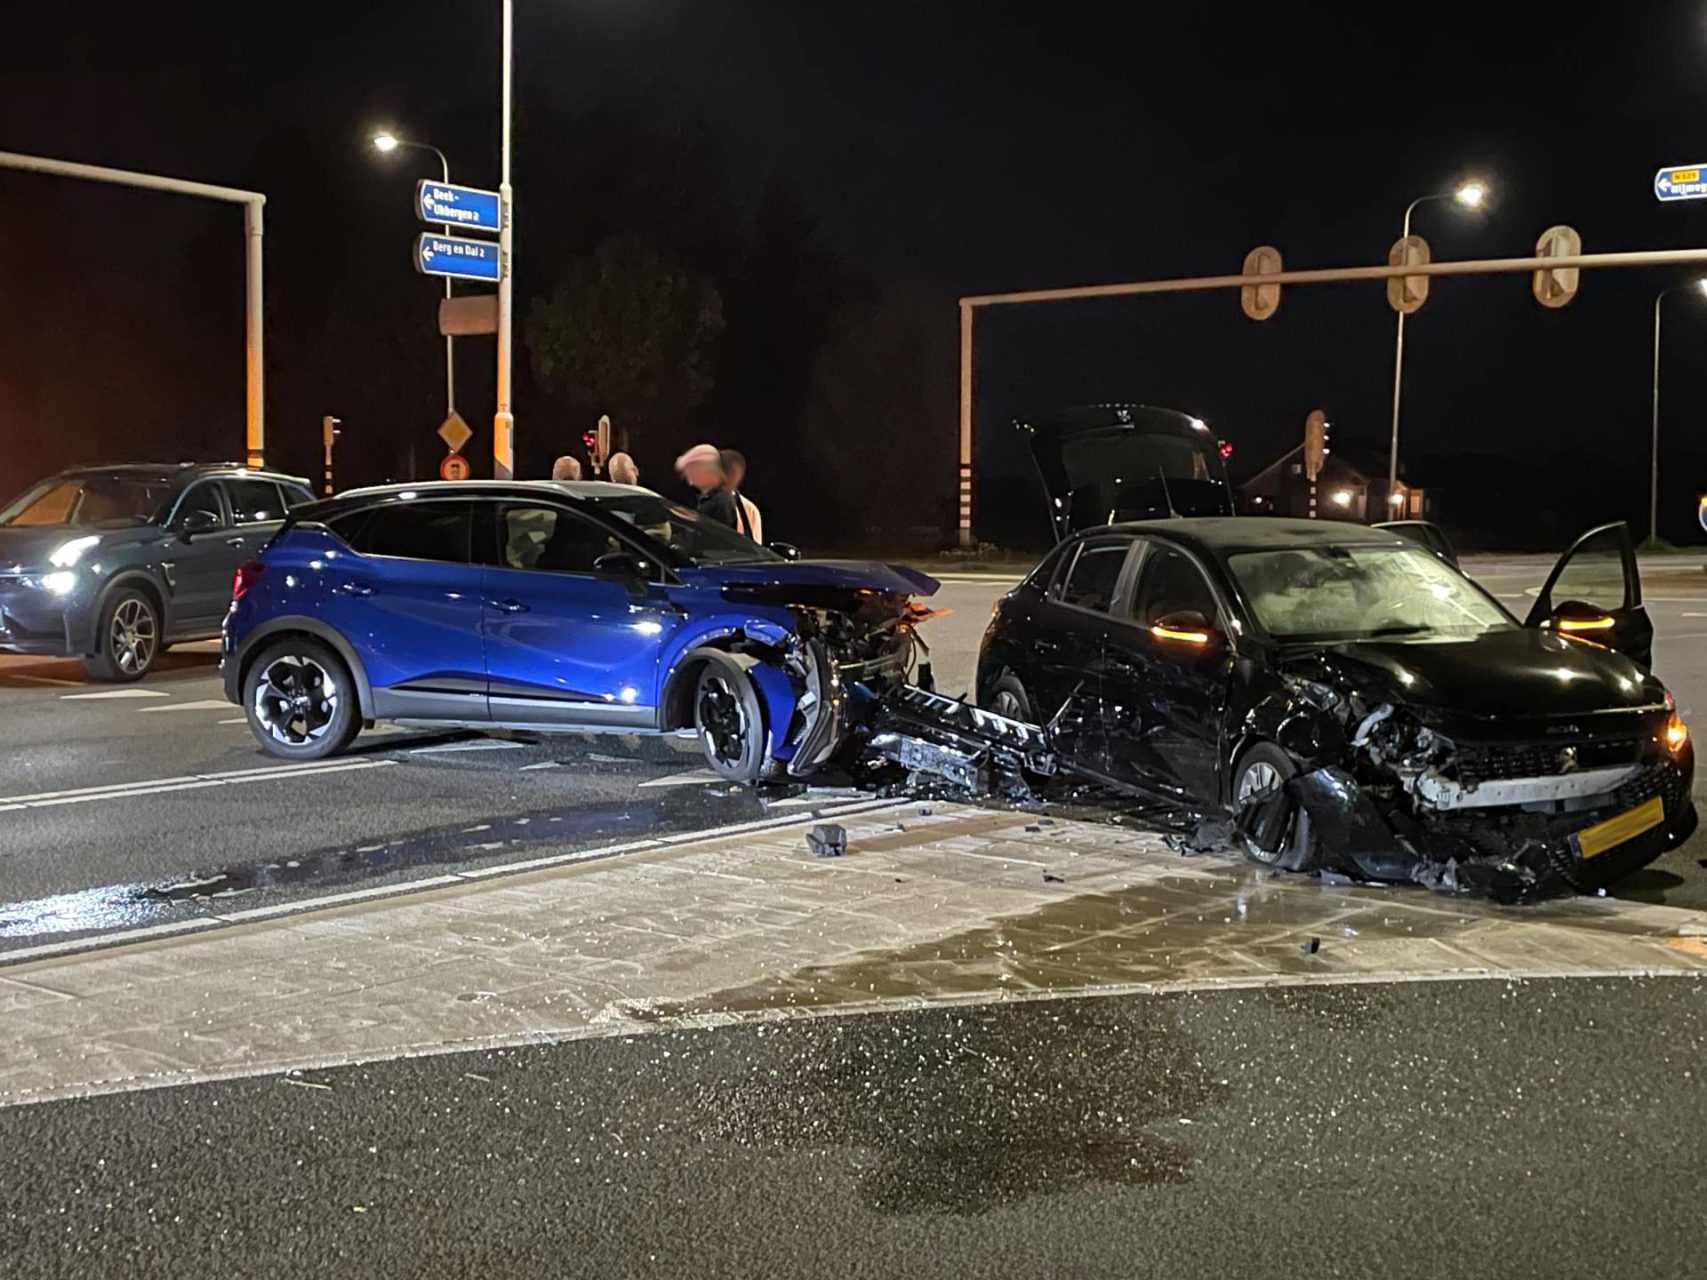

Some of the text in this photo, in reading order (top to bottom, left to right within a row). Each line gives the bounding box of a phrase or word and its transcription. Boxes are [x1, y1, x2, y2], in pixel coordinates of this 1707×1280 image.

[432, 240, 485, 257] Berg en Dal 2
